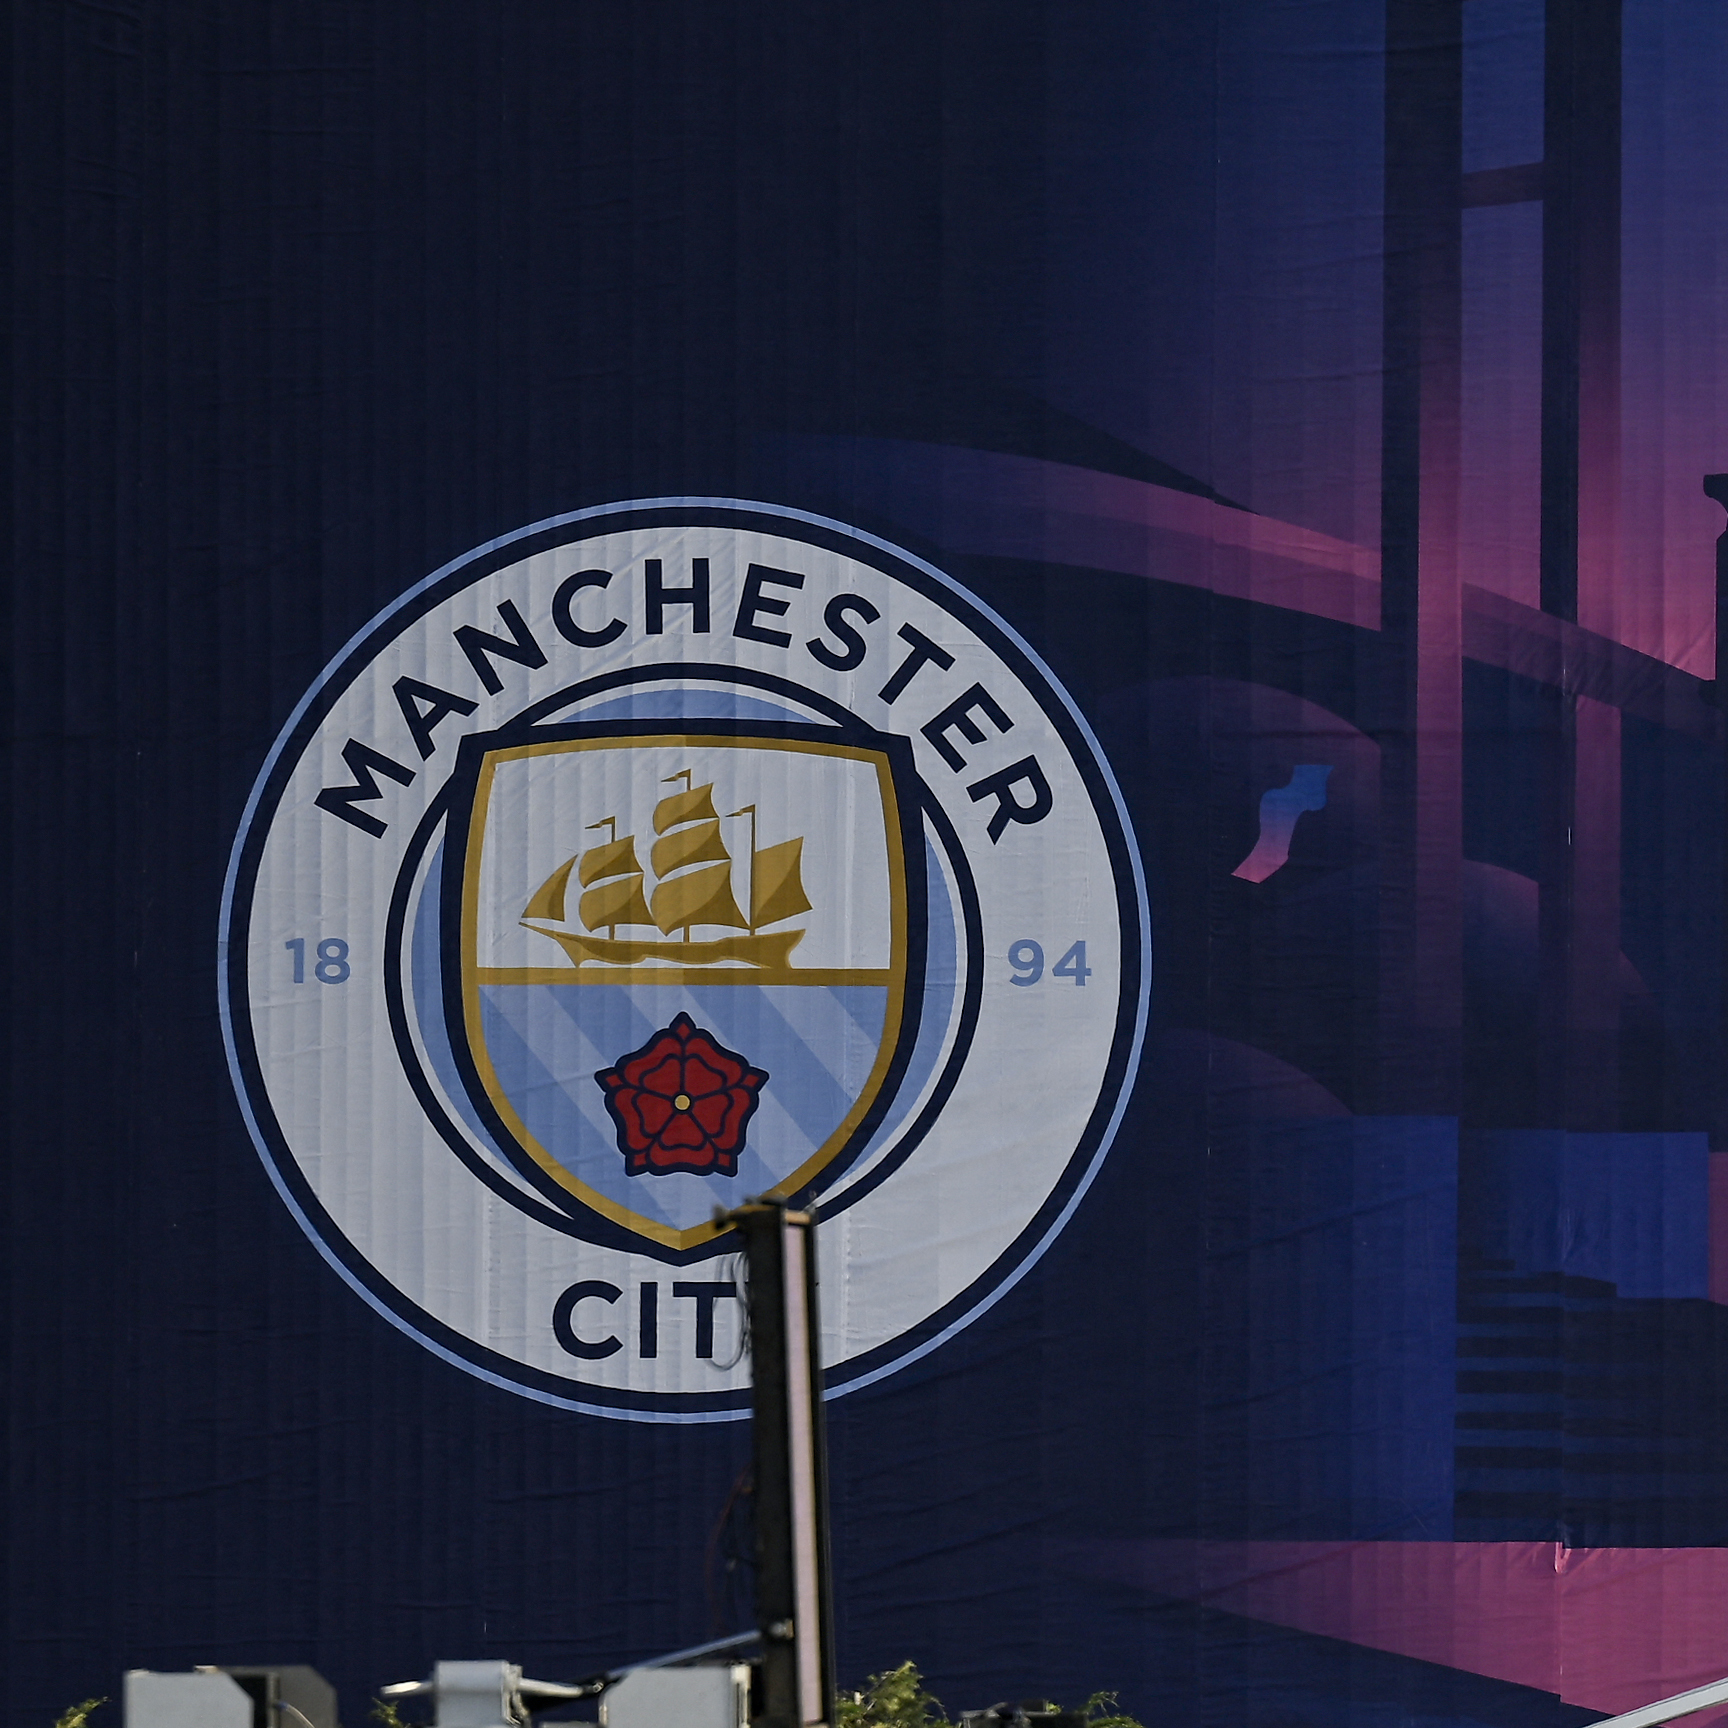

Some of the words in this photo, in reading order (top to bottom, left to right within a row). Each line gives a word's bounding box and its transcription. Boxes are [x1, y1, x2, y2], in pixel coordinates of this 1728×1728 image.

[313, 557, 1054, 845] MANCHESTER
[284, 936, 352, 985] 18
[1008, 939, 1093, 988] 94
[552, 1279, 755, 1360] CIT
